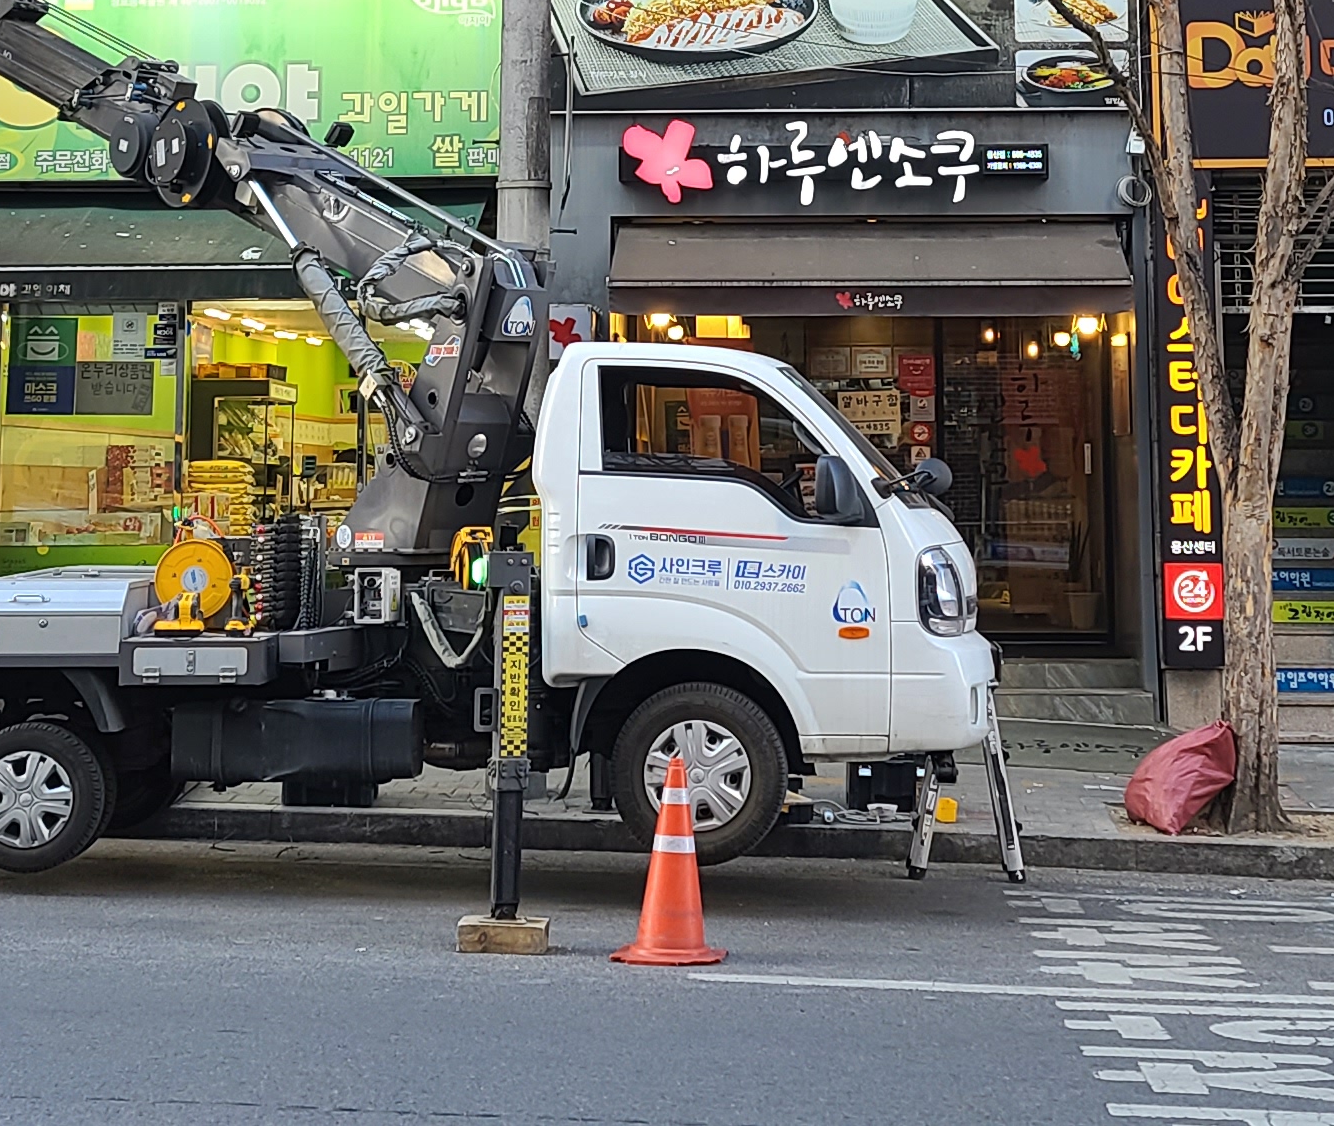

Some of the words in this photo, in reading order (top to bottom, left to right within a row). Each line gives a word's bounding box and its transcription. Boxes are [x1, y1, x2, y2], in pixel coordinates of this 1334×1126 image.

[338, 90, 488, 135] 과일가게
[431, 135, 465, 168] 쌀
[716, 120, 981, 207] 하루엔소쿠
[508, 320, 536, 337] TON
[80, 363, 153, 380] 온누리상품권
[649, 533, 698, 545] BONGO
[1170, 540, 1217, 556] 용산센터
[658, 557, 723, 577] 사인크루
[1179, 580, 1208, 599] 24
[840, 606, 877, 625] TON
[1178, 625, 1213, 653] 2F
